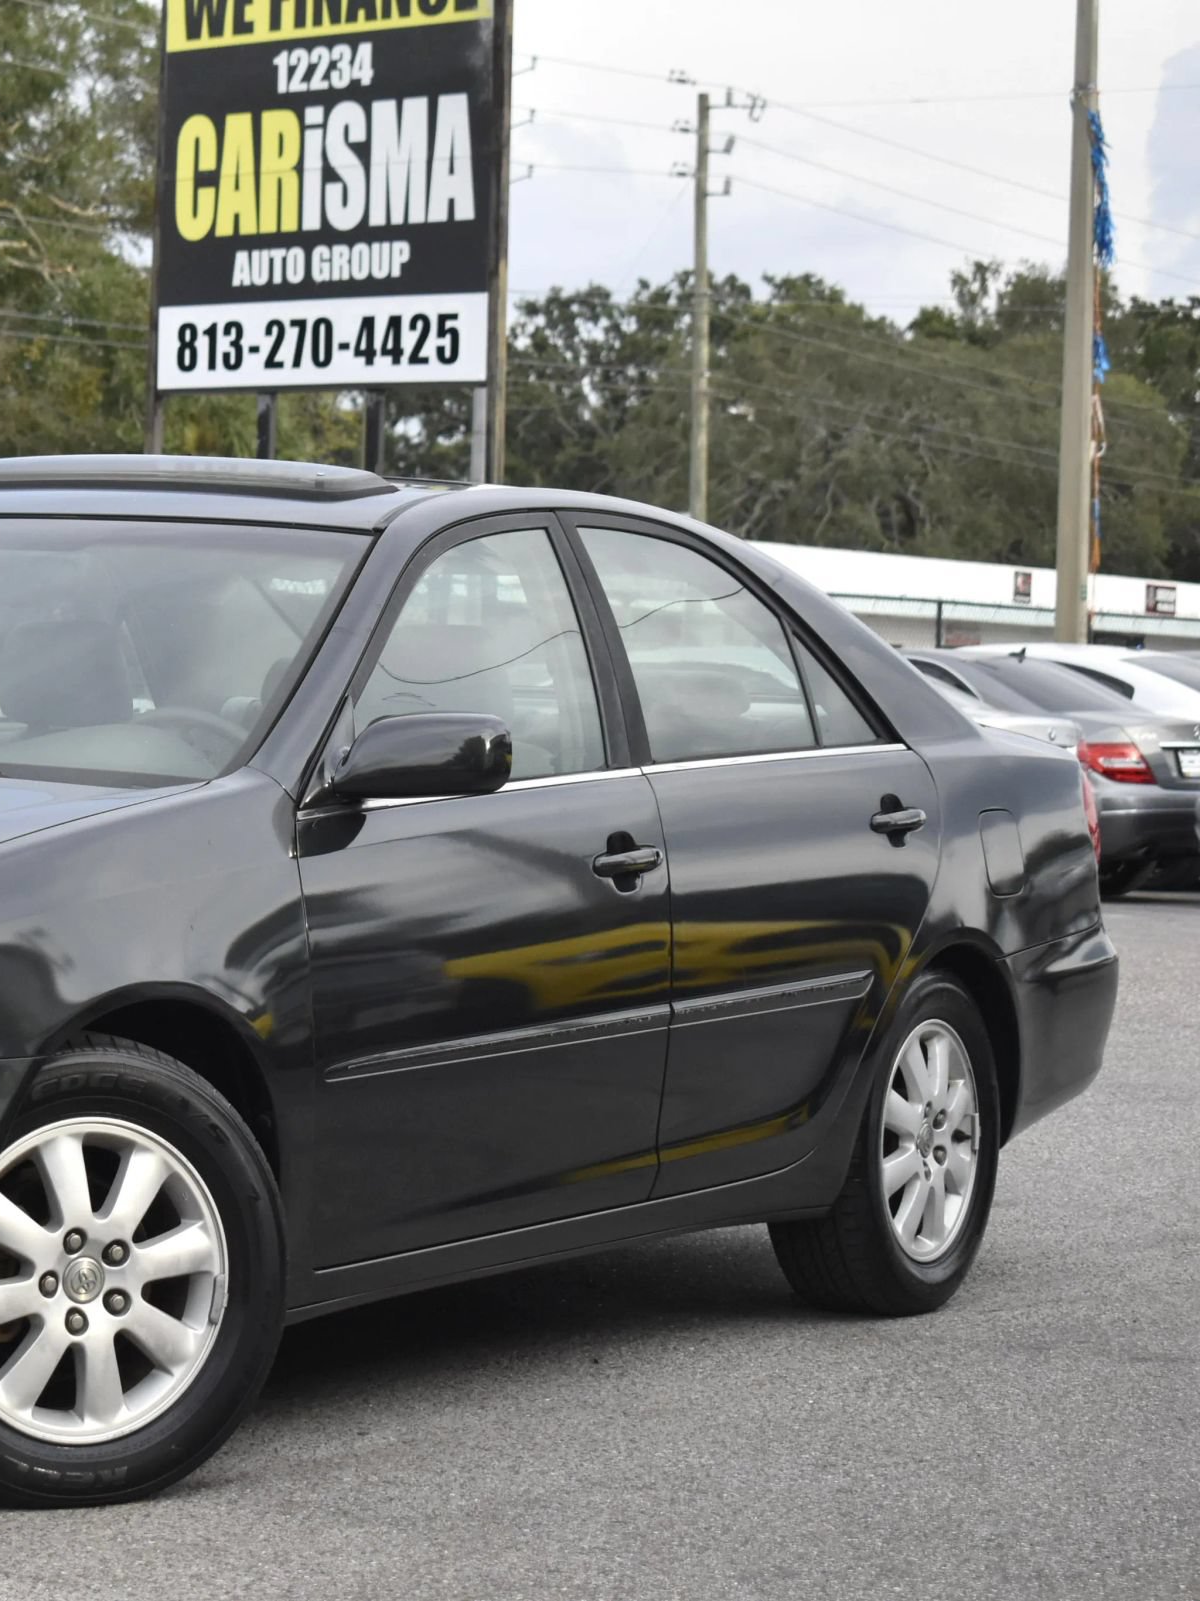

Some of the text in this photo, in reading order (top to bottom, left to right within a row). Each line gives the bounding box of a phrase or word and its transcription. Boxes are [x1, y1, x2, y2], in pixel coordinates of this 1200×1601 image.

[184, 0, 254, 41] WE
[272, 42, 374, 94] 12234
[232, 241, 411, 287] AUTO GROUP
[177, 313, 460, 372] 813-270-4425
